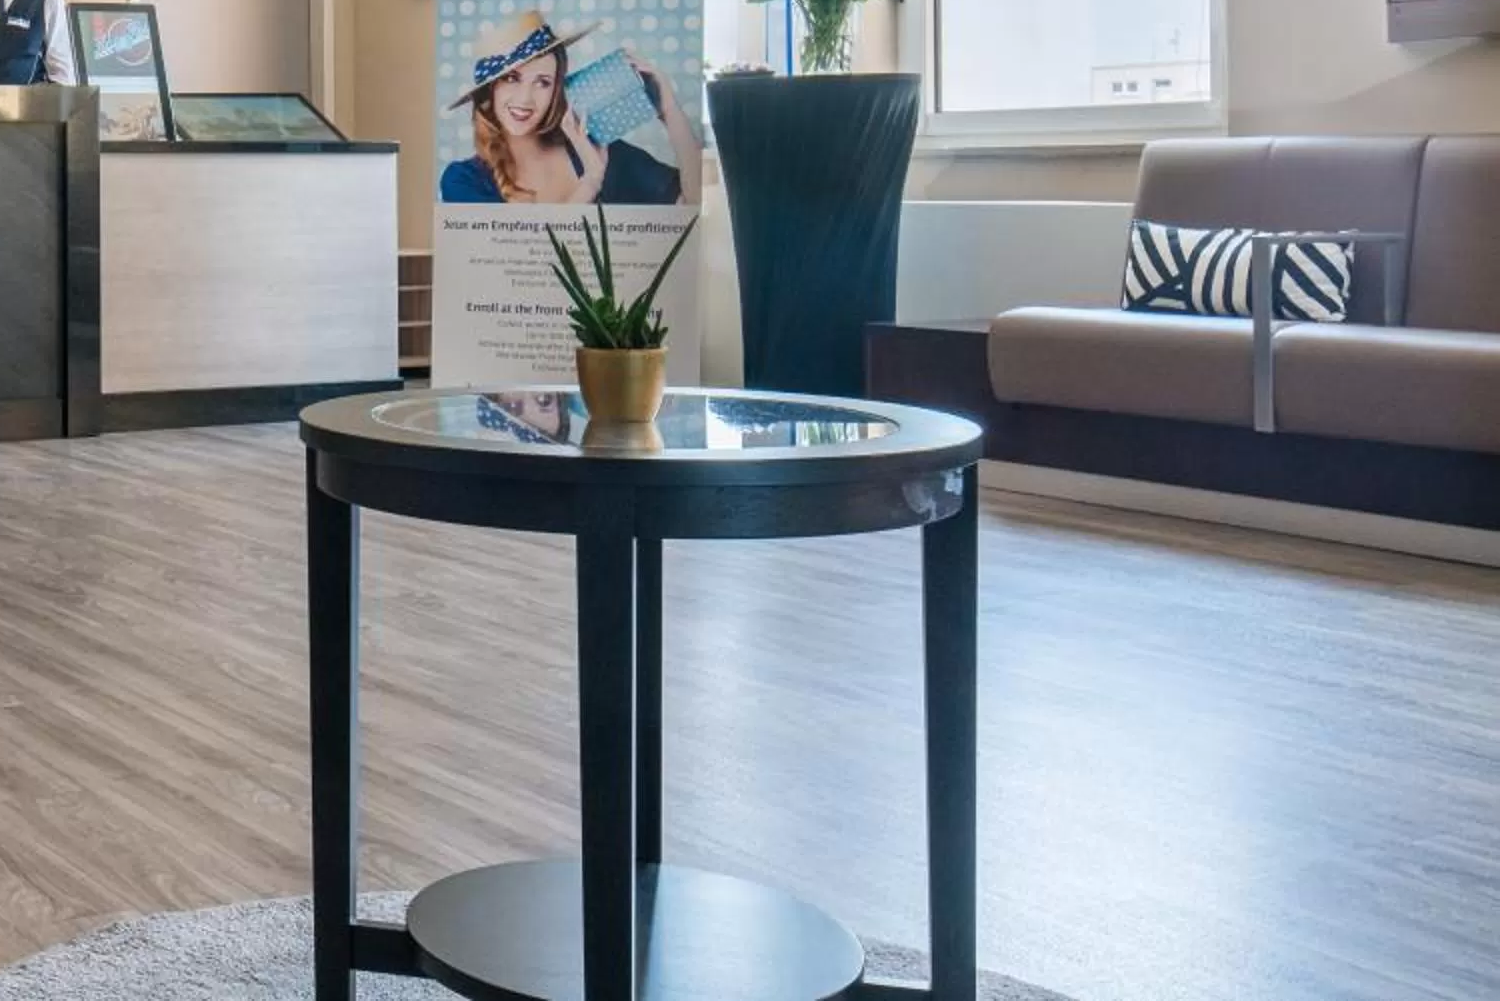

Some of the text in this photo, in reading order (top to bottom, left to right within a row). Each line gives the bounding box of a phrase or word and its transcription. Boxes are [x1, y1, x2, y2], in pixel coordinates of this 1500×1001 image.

[471, 221, 489, 230] am
[491, 220, 540, 233] Empfang
[465, 302, 499, 312] Enroll
[501, 304, 512, 313] at
[515, 303, 532, 314] the
[535, 304, 563, 315] front
